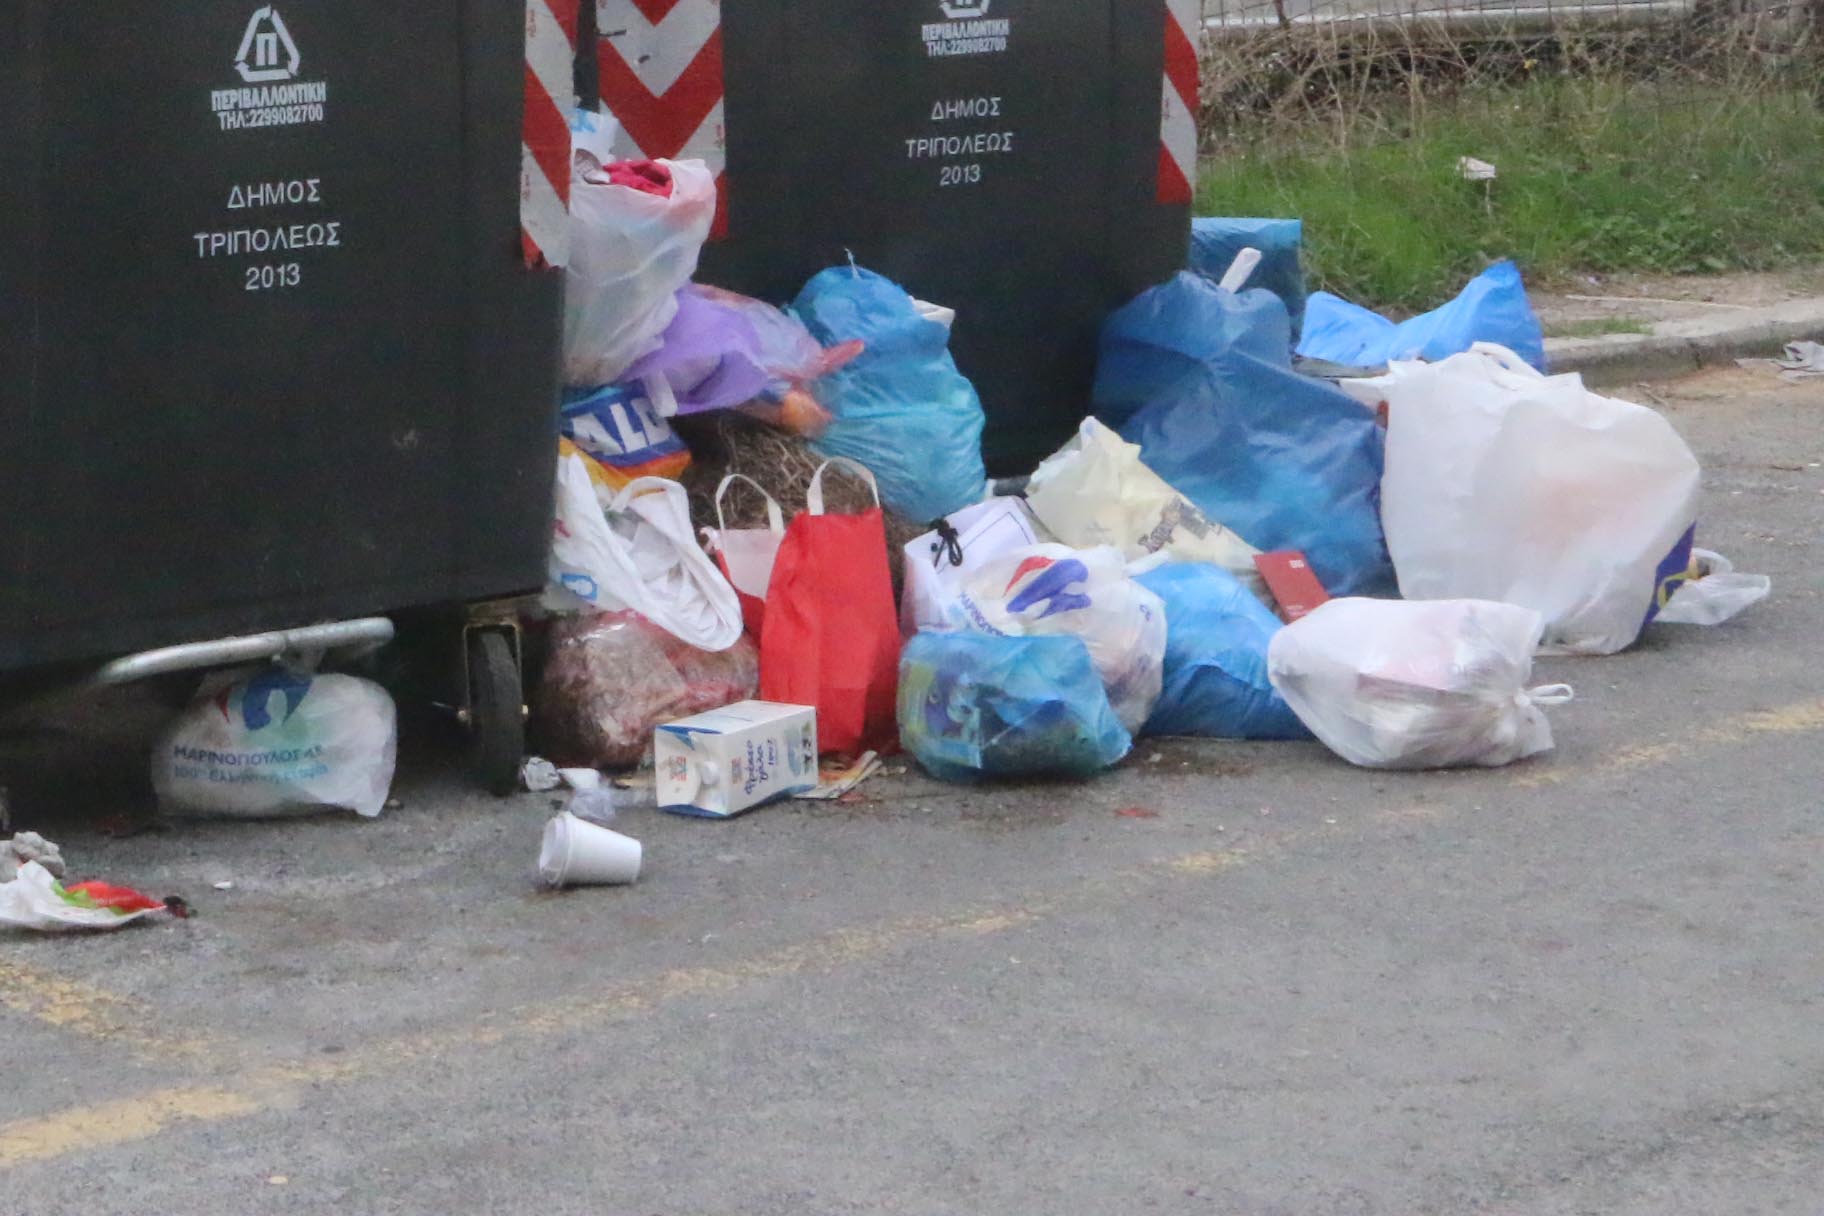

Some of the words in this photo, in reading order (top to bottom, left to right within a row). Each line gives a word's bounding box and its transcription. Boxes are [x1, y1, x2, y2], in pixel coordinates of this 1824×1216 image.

[211, 81, 326, 112] ΠΕΡΙΒΑΛΛΟΝΤΙΚΗ
[931, 97, 1001, 120] ΔΗΜΟΣ
[905, 132, 1014, 159] ΤΡΙΠΟΛΕΩΣ
[940, 164, 981, 186] 2013
[227, 179, 321, 208] ΔΗΜΟΣ
[193, 222, 340, 259] ΤΡΙΠΟΛΕΩΣ
[245, 263, 301, 290] 2013
